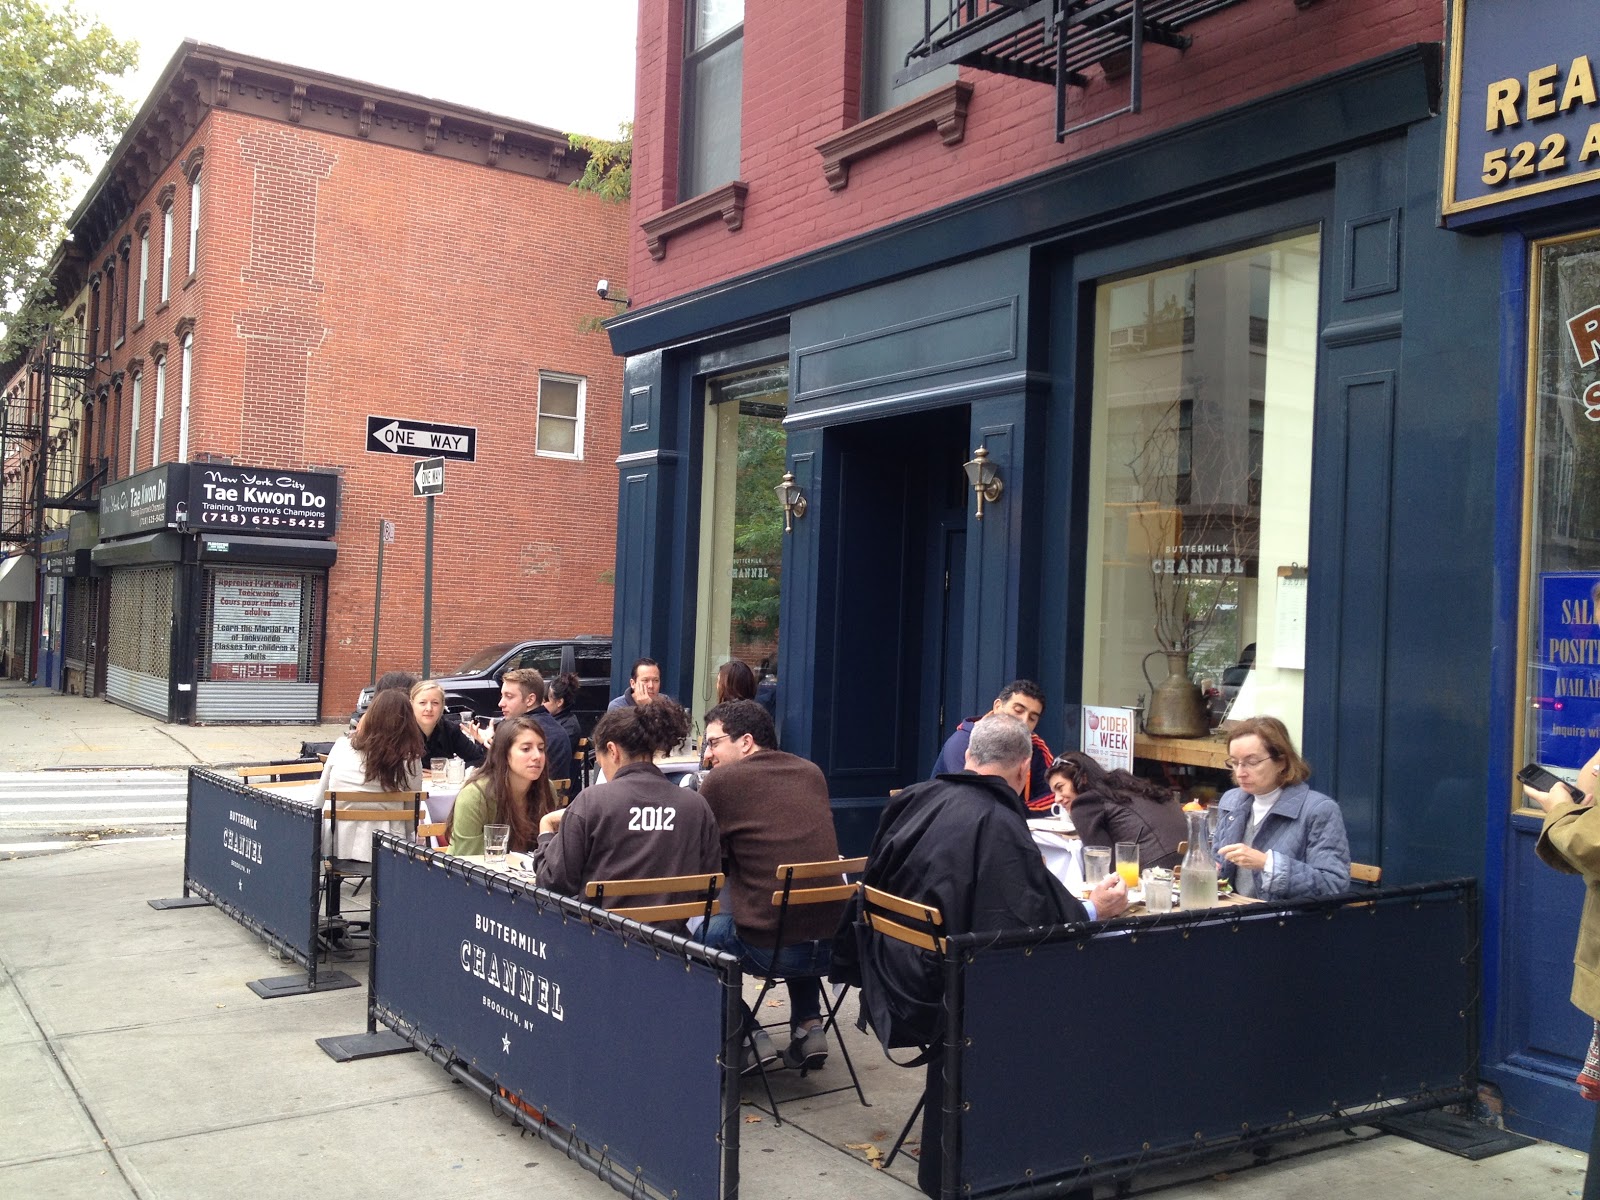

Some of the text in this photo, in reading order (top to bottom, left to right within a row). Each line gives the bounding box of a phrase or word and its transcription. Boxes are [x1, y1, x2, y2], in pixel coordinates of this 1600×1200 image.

[1485, 54, 1597, 132] REA
[1481, 122, 1600, 185] 522 A
[384, 429, 462, 450] ONE WAY
[204, 470, 305, 491] New York City
[422, 468, 442, 485] ONE WAY
[130, 487, 140, 508] Tae
[141, 483, 157, 505] Kwon
[157, 478, 166, 500] Do
[203, 483, 326, 508] Tae Kwon Do
[202, 502, 325, 518] Training Tomorrow's Champions
[202, 512, 325, 529] (718) 625-5425
[1165, 544, 1229, 554] BUTTERMILK
[1152, 558, 1244, 574] CHANNEL
[1100, 716, 1128, 734] CIDER
[1553, 722, 1585, 738] Inquire
[1100, 732, 1128, 751] WEEK
[229, 810, 258, 831] BUTTERMILK
[628, 806, 676, 831] 2012
[223, 827, 263, 865] CHANNEL
[475, 913, 547, 960] BUTTERMILK
[460, 939, 564, 1022] CHANNEL
[482, 995, 534, 1032] BROOKLYN, NY
